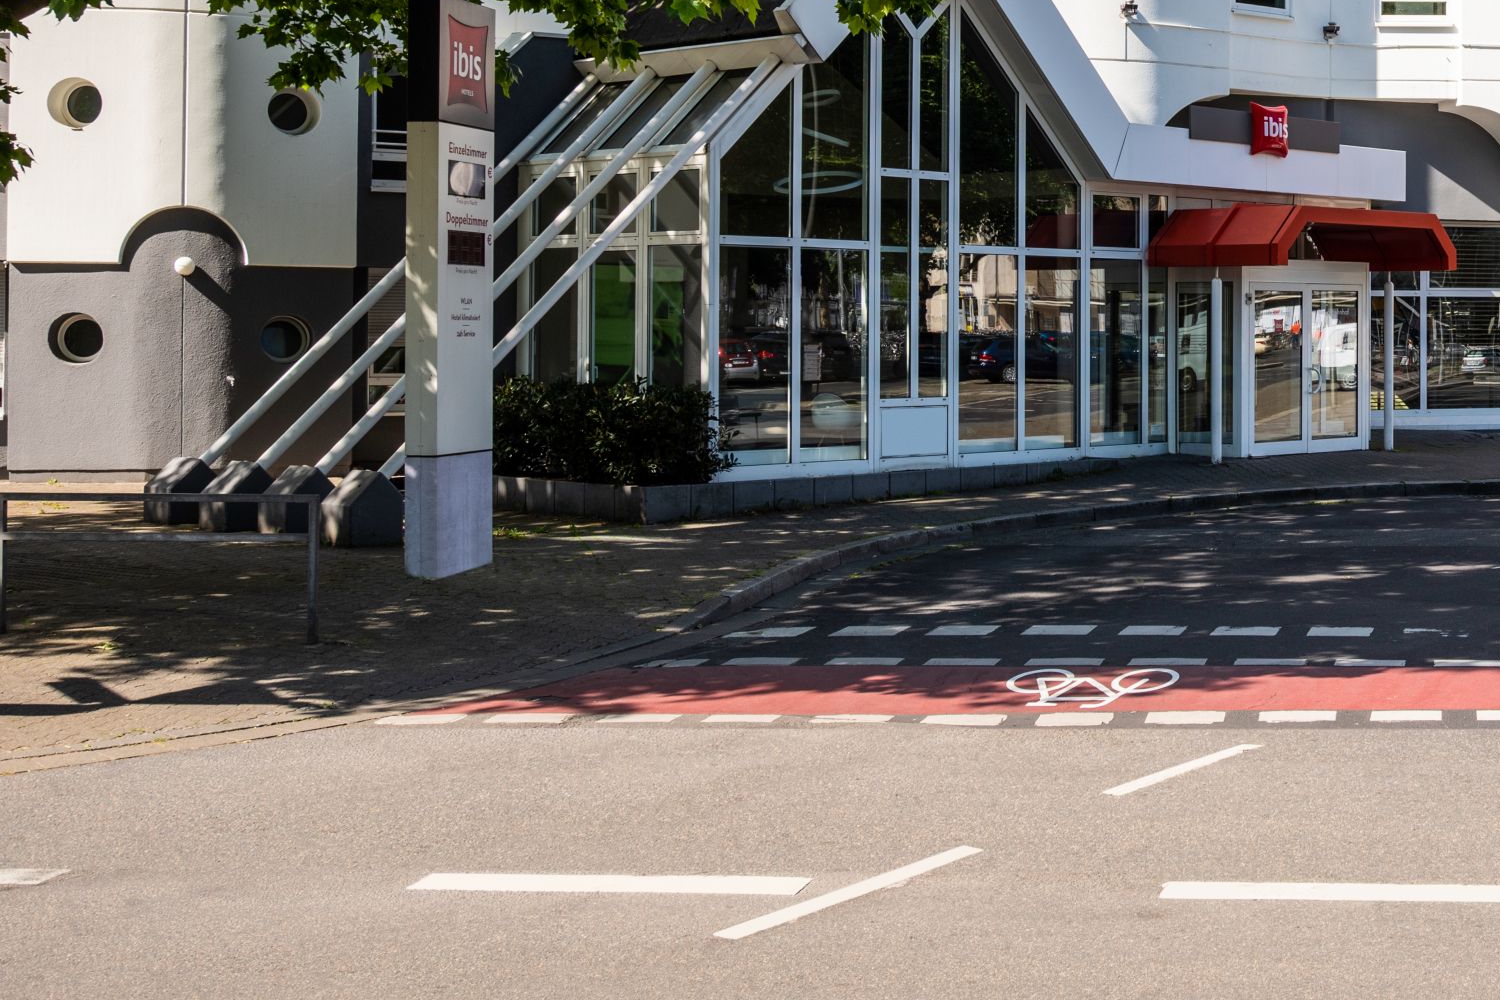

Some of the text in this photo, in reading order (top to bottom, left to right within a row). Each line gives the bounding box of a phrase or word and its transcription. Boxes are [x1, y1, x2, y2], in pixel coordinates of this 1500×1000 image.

[453, 41, 482, 81] ibis
[1263, 116, 1288, 139] ibis
[448, 141, 487, 159] Einzelzimmer
[446, 211, 488, 229] Doppelzimmer
